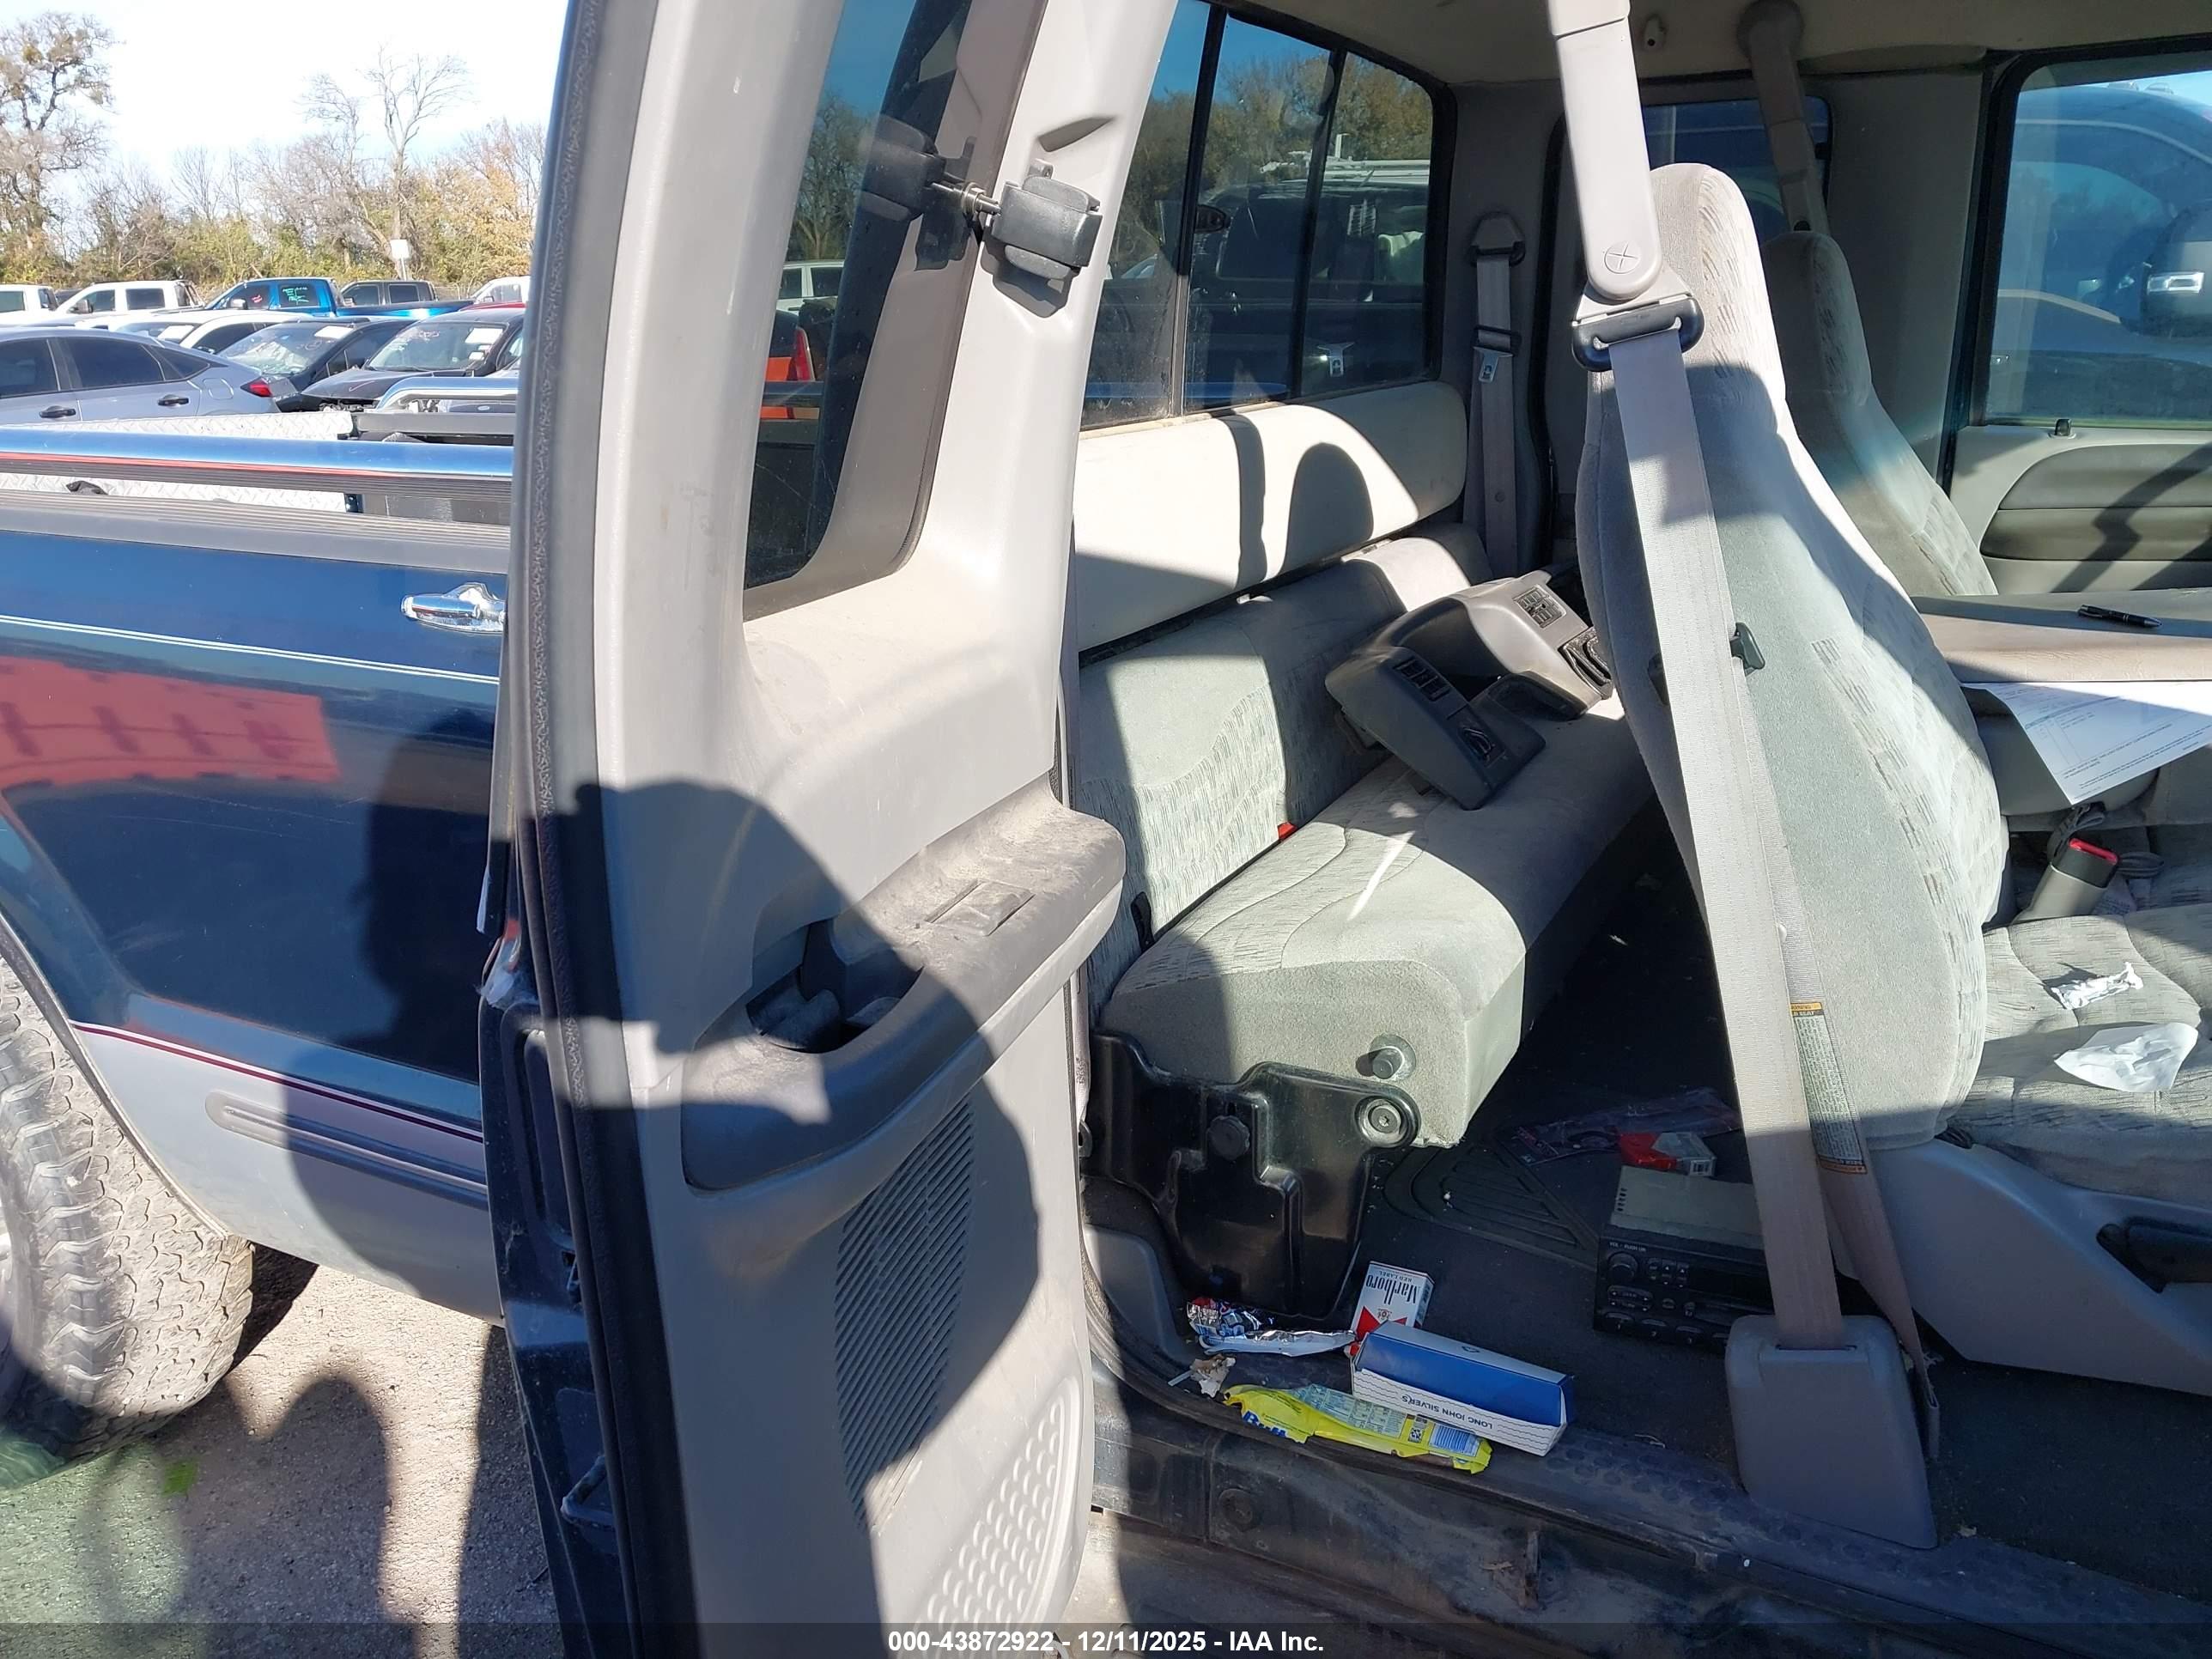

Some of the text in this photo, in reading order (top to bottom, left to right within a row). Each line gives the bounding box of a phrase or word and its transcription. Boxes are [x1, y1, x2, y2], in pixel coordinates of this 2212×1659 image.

[1378, 1271, 1399, 1279] LABEL
[1365, 1275, 1418, 1305] Marlboro
[1401, 1395, 1439, 1413] SILVER'S
[1442, 1407, 1467, 1421] JOHN
[1468, 1417, 1493, 1430] LONG
